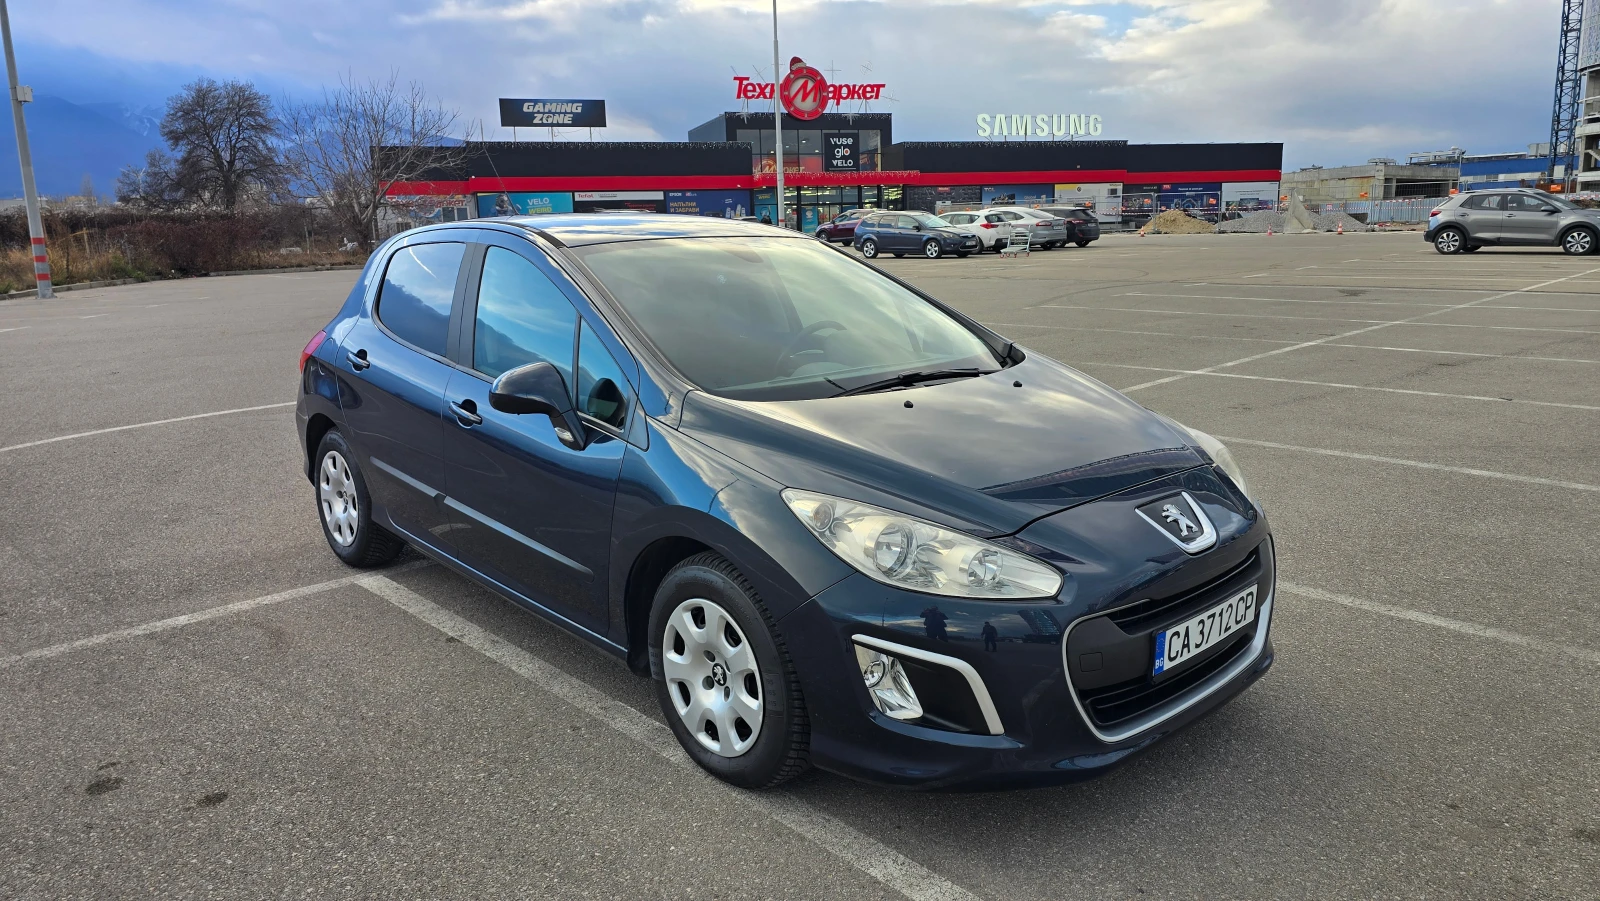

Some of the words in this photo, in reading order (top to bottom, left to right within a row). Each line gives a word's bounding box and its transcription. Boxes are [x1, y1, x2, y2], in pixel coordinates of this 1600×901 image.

[522, 102, 583, 113] GAMING
[533, 113, 574, 124] ZONE
[976, 113, 1102, 137] SAMSUNG
[834, 146, 850, 158] glo
[832, 159, 853, 167] VELO
[527, 197, 549, 205] VELO
[528, 206, 552, 214] WEIRD
[1155, 657, 1164, 669] BG
